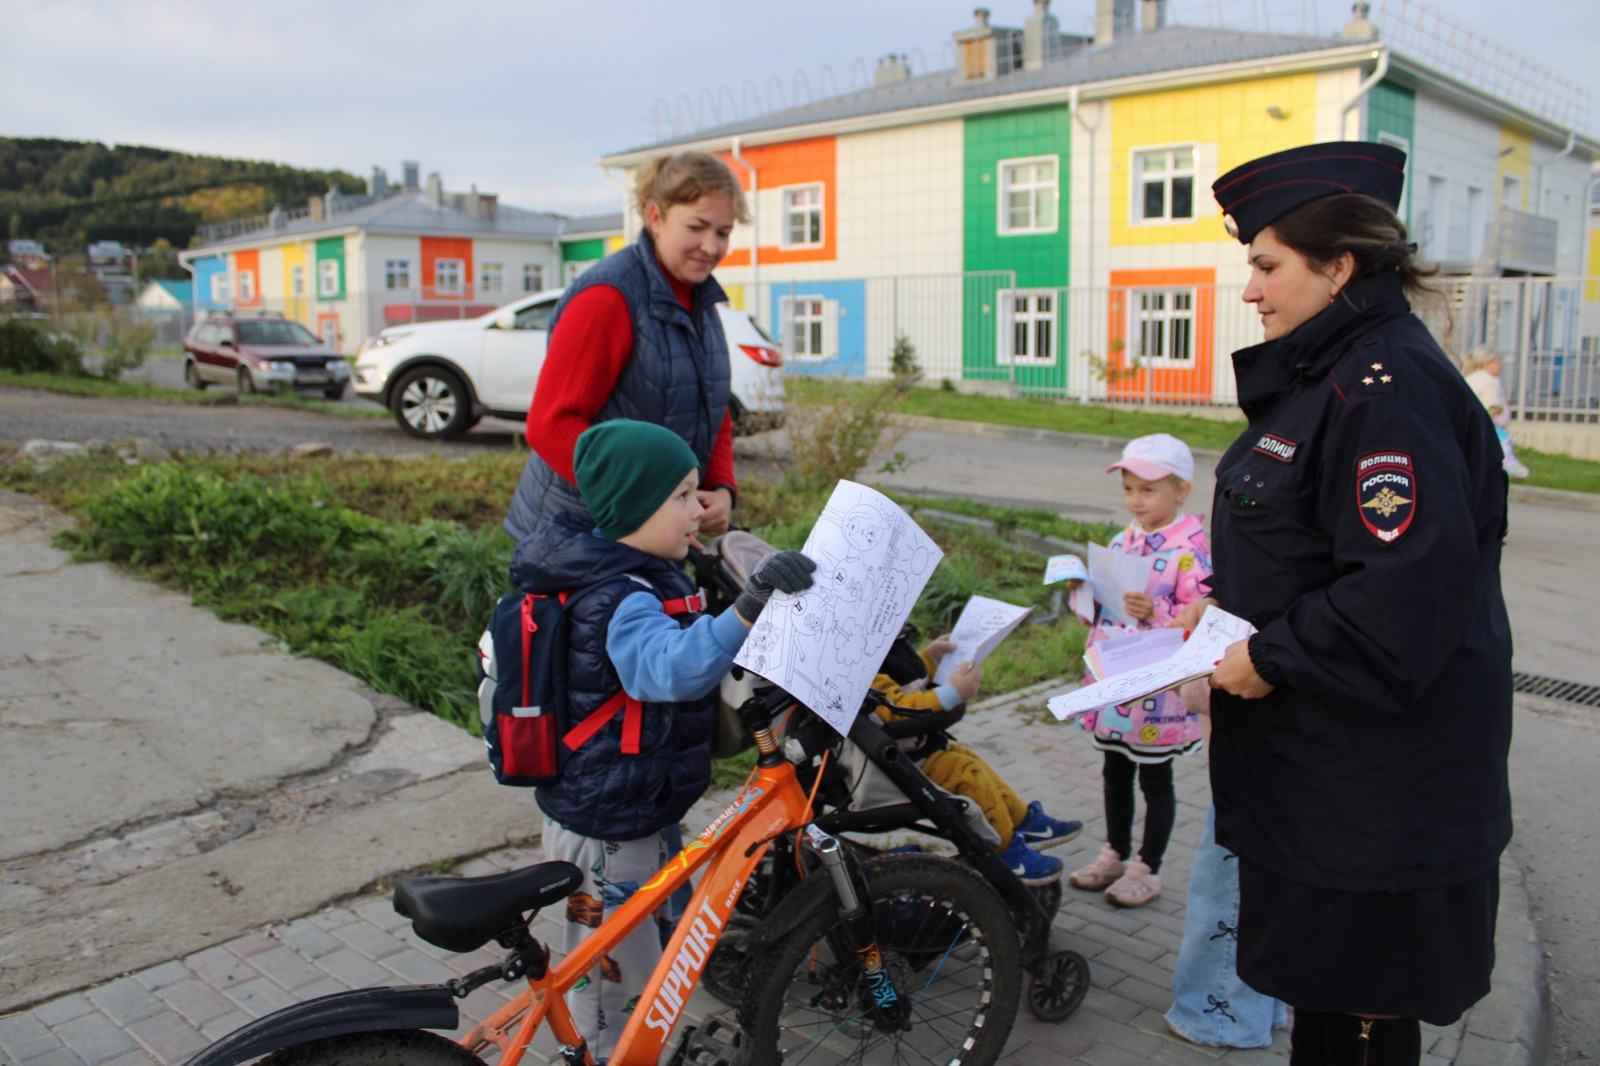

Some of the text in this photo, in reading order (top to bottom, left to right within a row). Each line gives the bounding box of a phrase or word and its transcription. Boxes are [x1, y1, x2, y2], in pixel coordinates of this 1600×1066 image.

[1256, 436, 1297, 459] ПОЛИЦИ
[1360, 454, 1408, 470] ПОЛИЦИЯ
[1362, 473, 1409, 492] РОССИЯ
[1377, 528, 1400, 541] МВД
[645, 879, 742, 1044] SUPPORT BIKE
